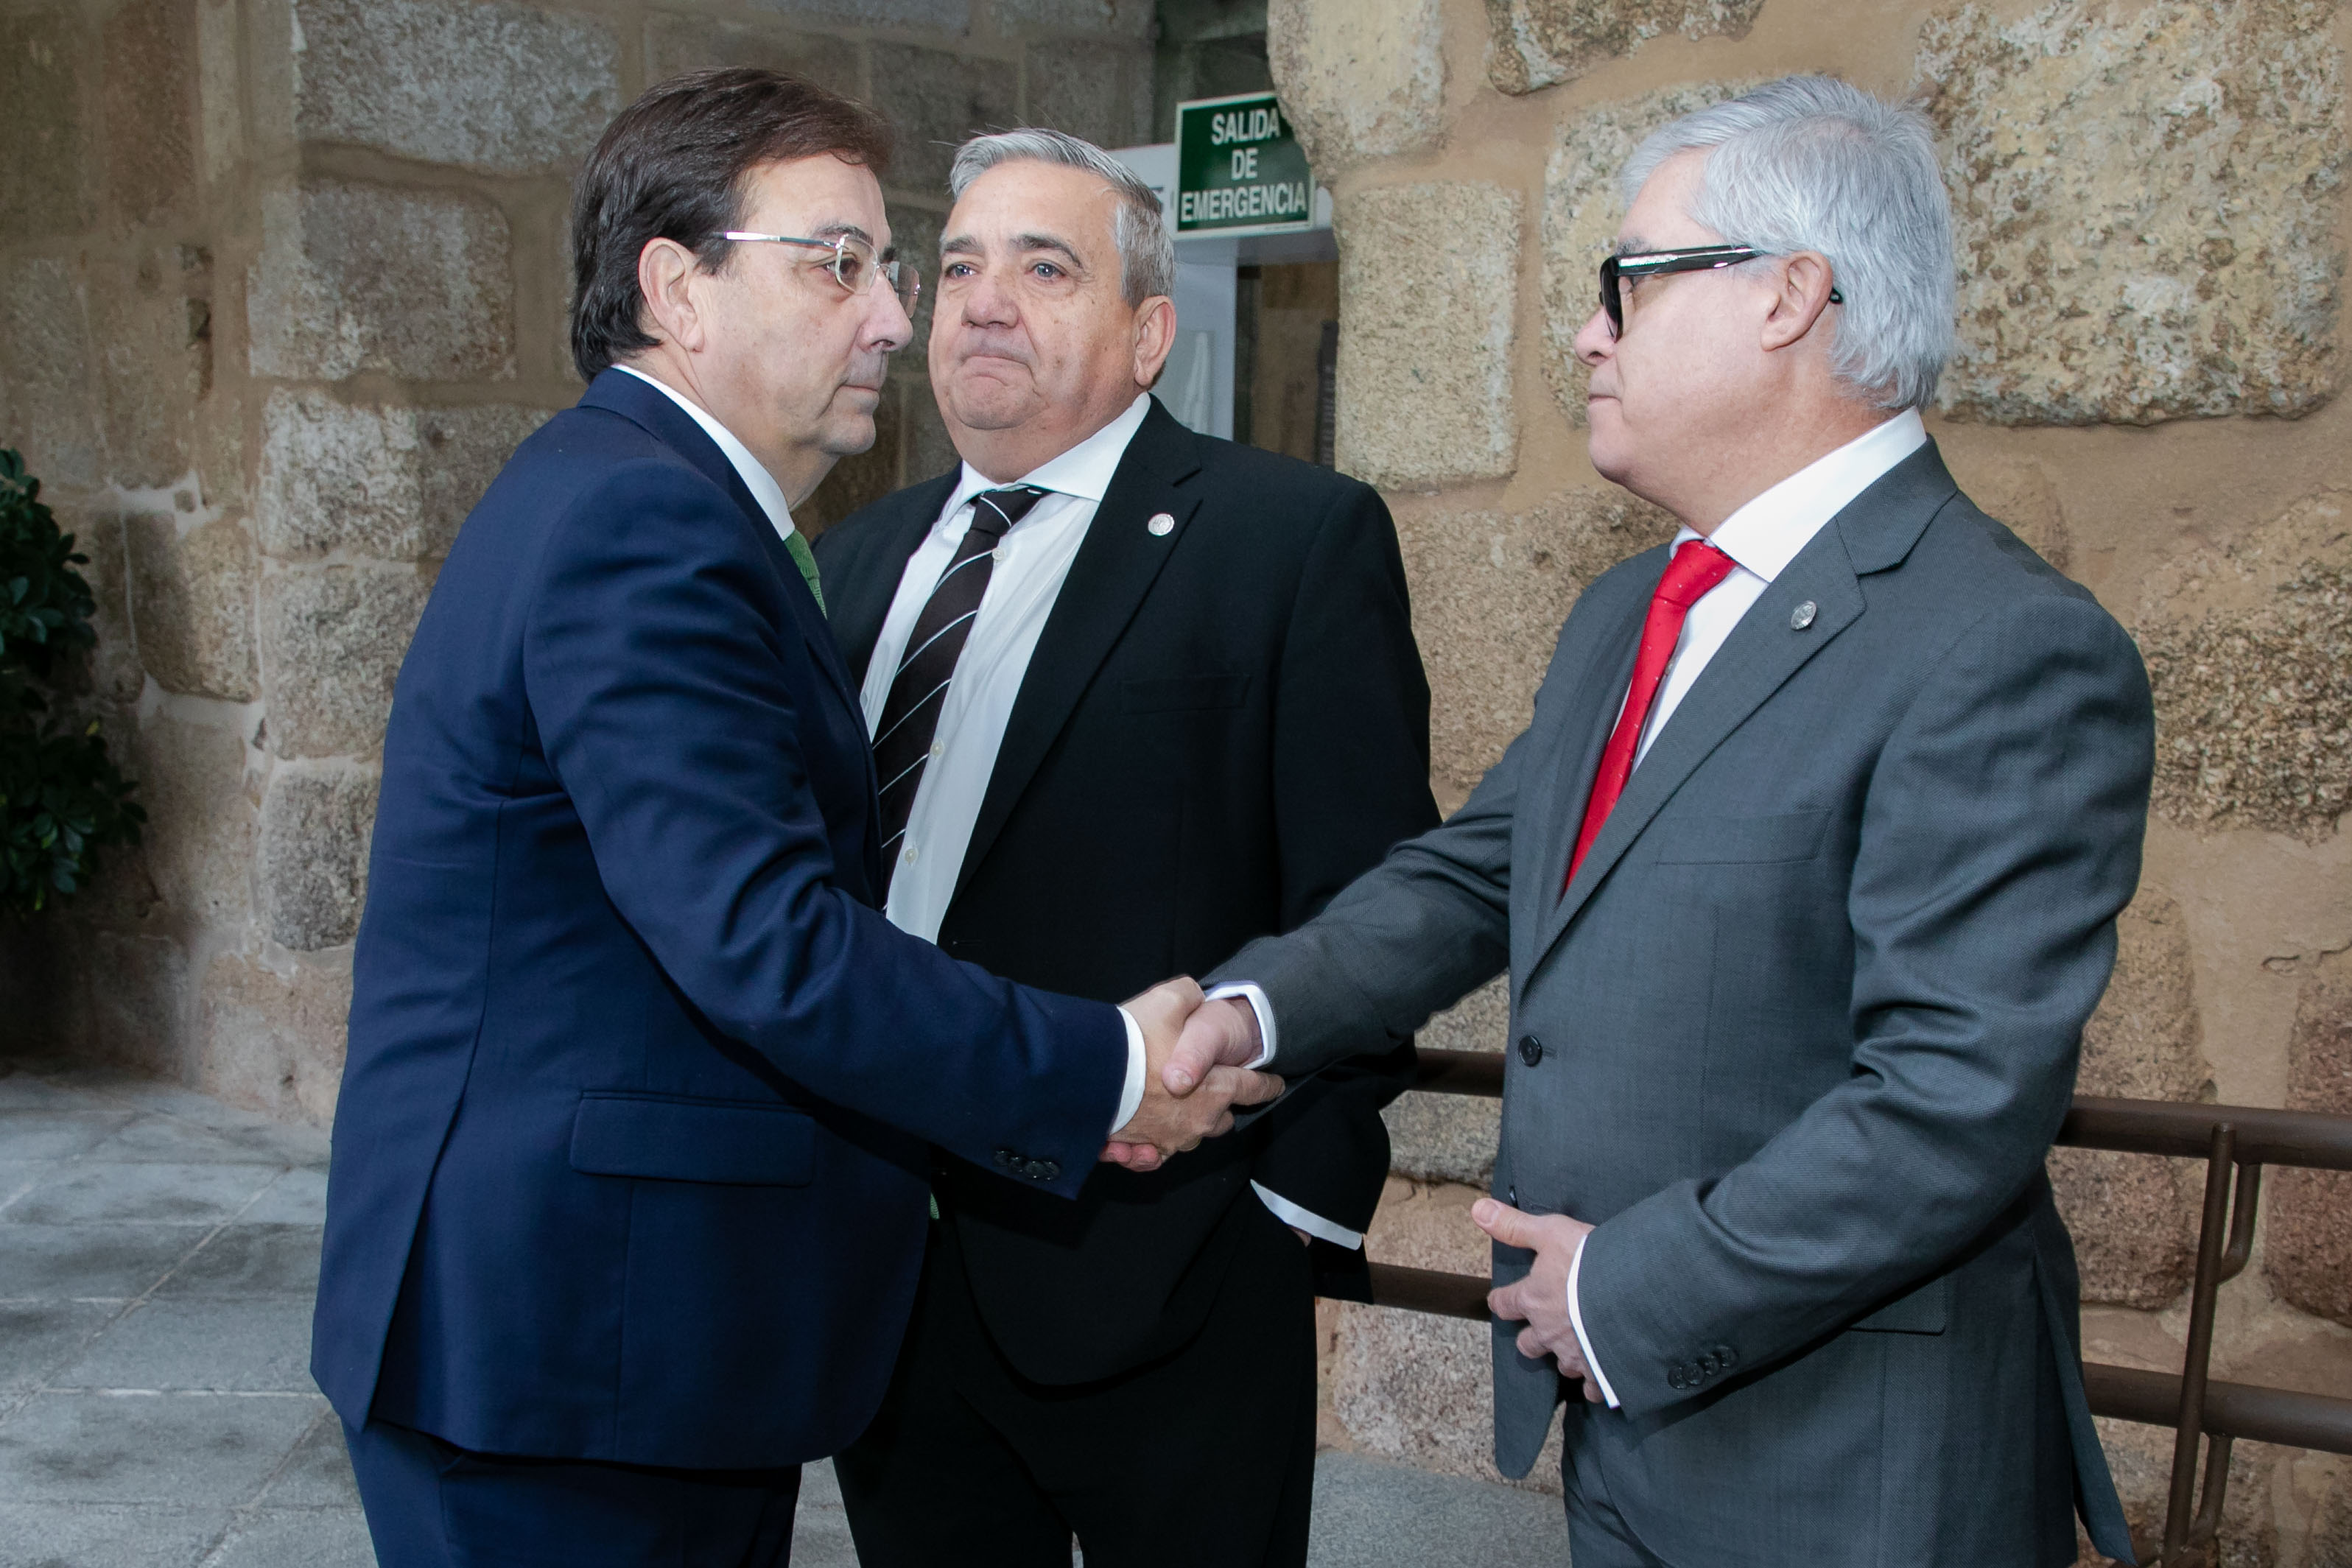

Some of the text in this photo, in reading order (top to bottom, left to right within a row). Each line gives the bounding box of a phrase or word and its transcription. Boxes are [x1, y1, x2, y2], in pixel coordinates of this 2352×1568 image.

[1212, 108, 1281, 145] SALIDA
[1231, 148, 1258, 180] DE
[1181, 183, 1307, 222] EMERGENCIA
